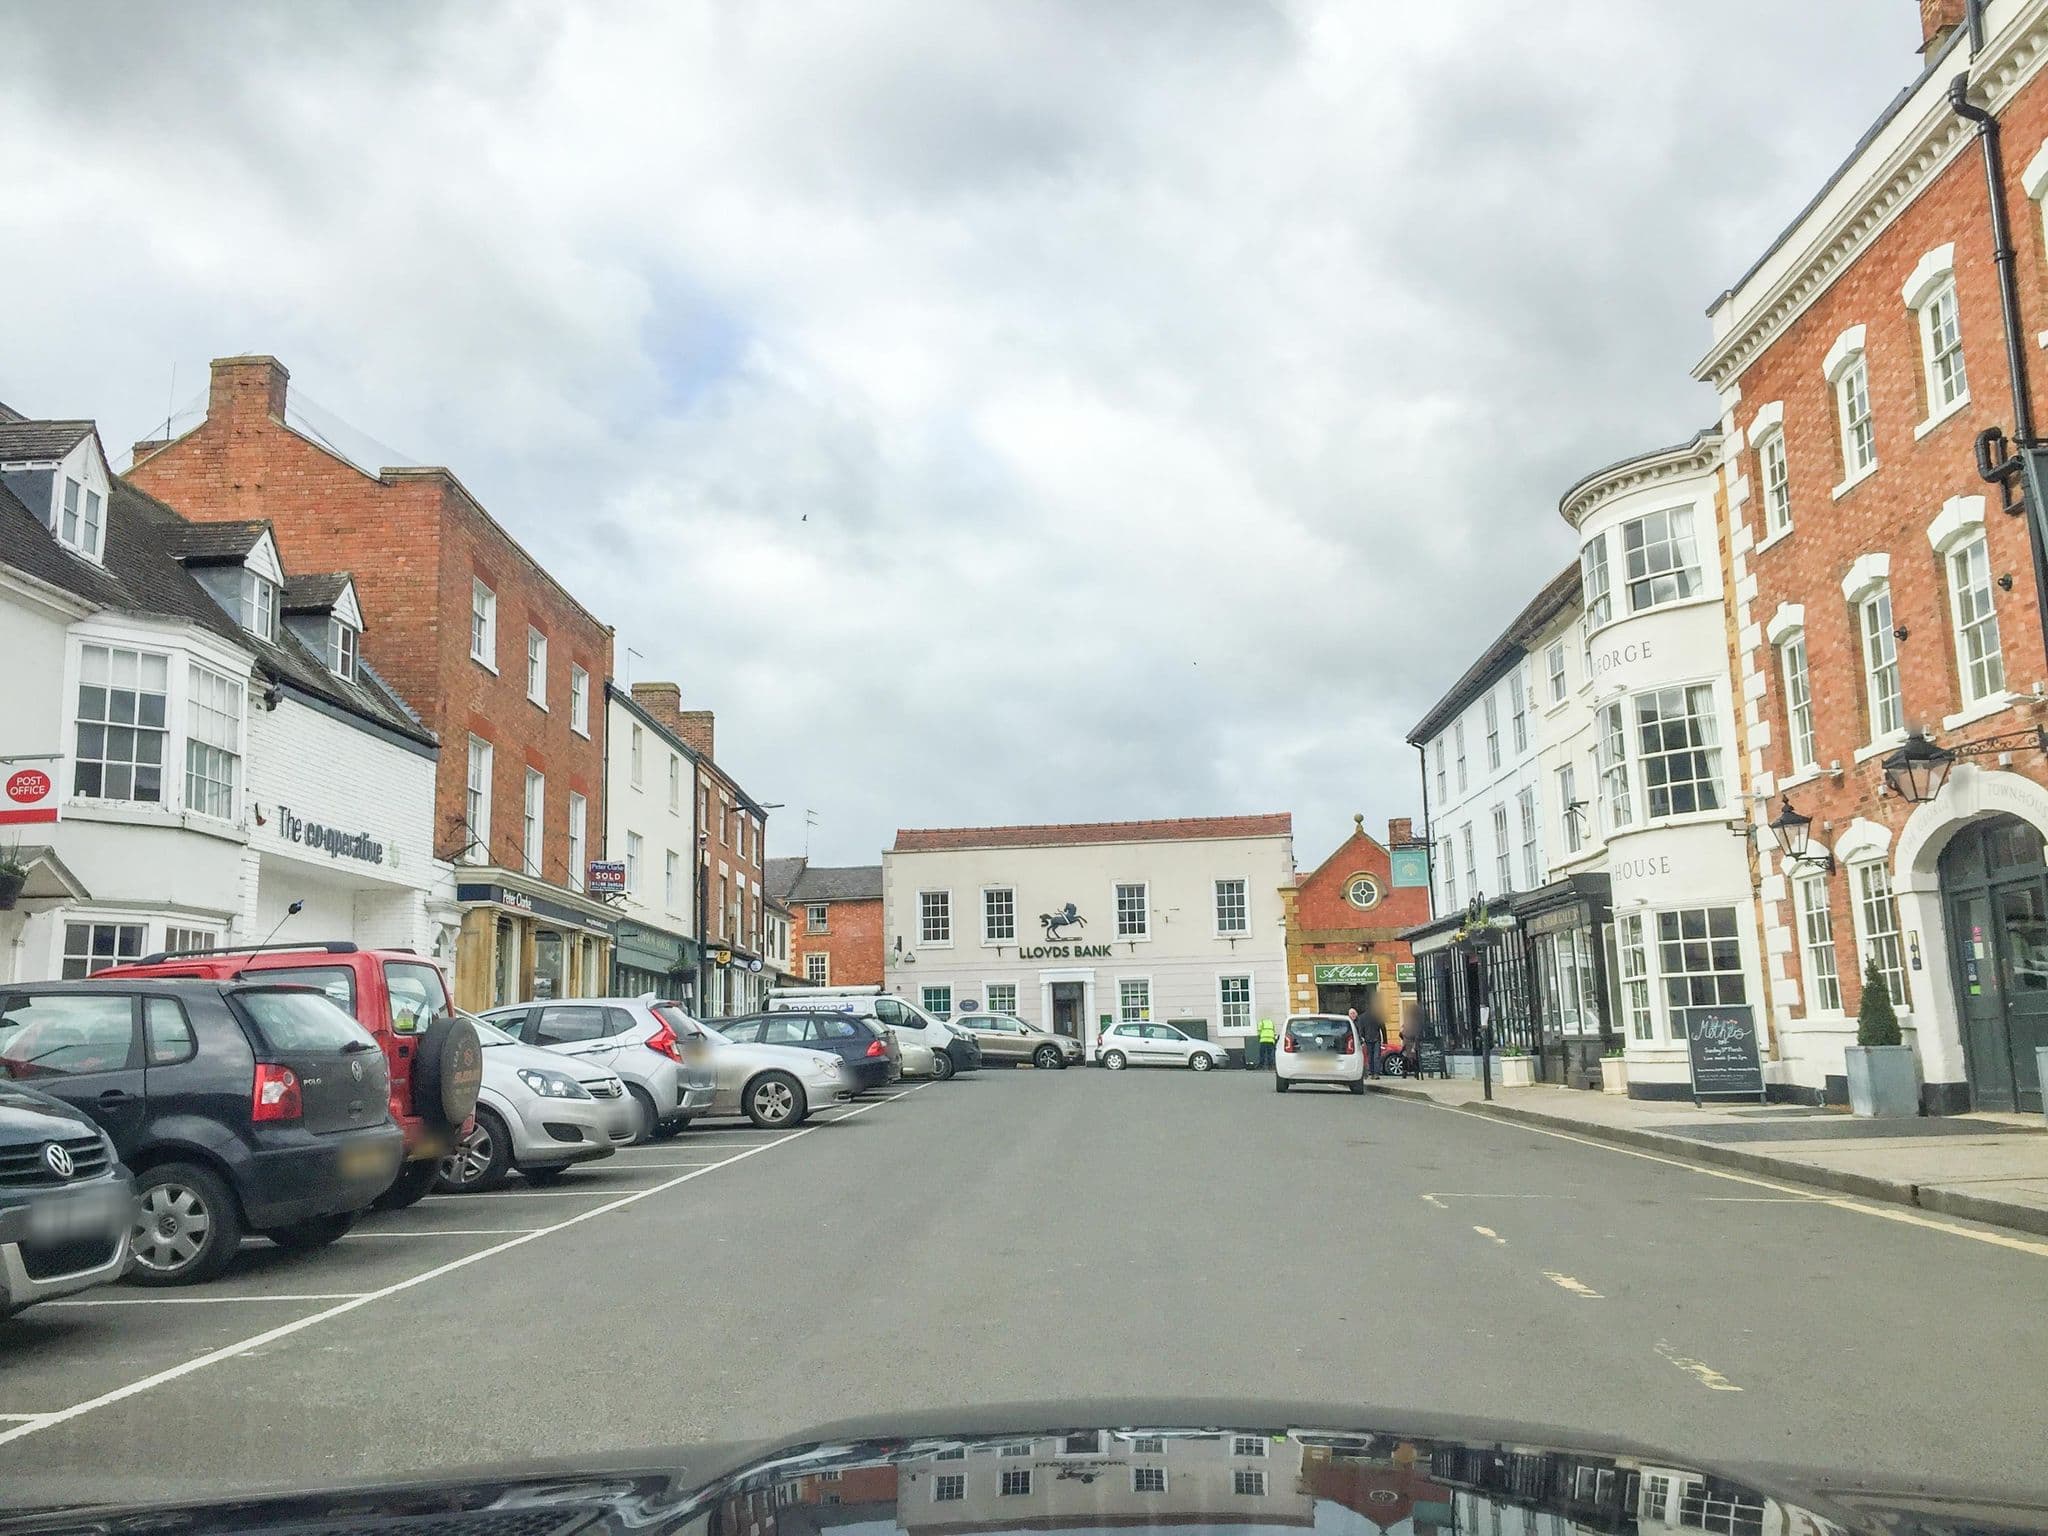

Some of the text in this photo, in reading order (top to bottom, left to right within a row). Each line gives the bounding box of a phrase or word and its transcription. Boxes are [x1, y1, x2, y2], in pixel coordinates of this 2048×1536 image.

[16, 776, 43, 786] POST
[10, 785, 46, 796] OFFICE
[278, 805, 302, 842] The
[1614, 856, 1671, 881] HOUSE
[595, 872, 621, 881] SOLD
[1019, 944, 1112, 959] LLOYDS BANK
[303, 1078, 321, 1087] POLO
